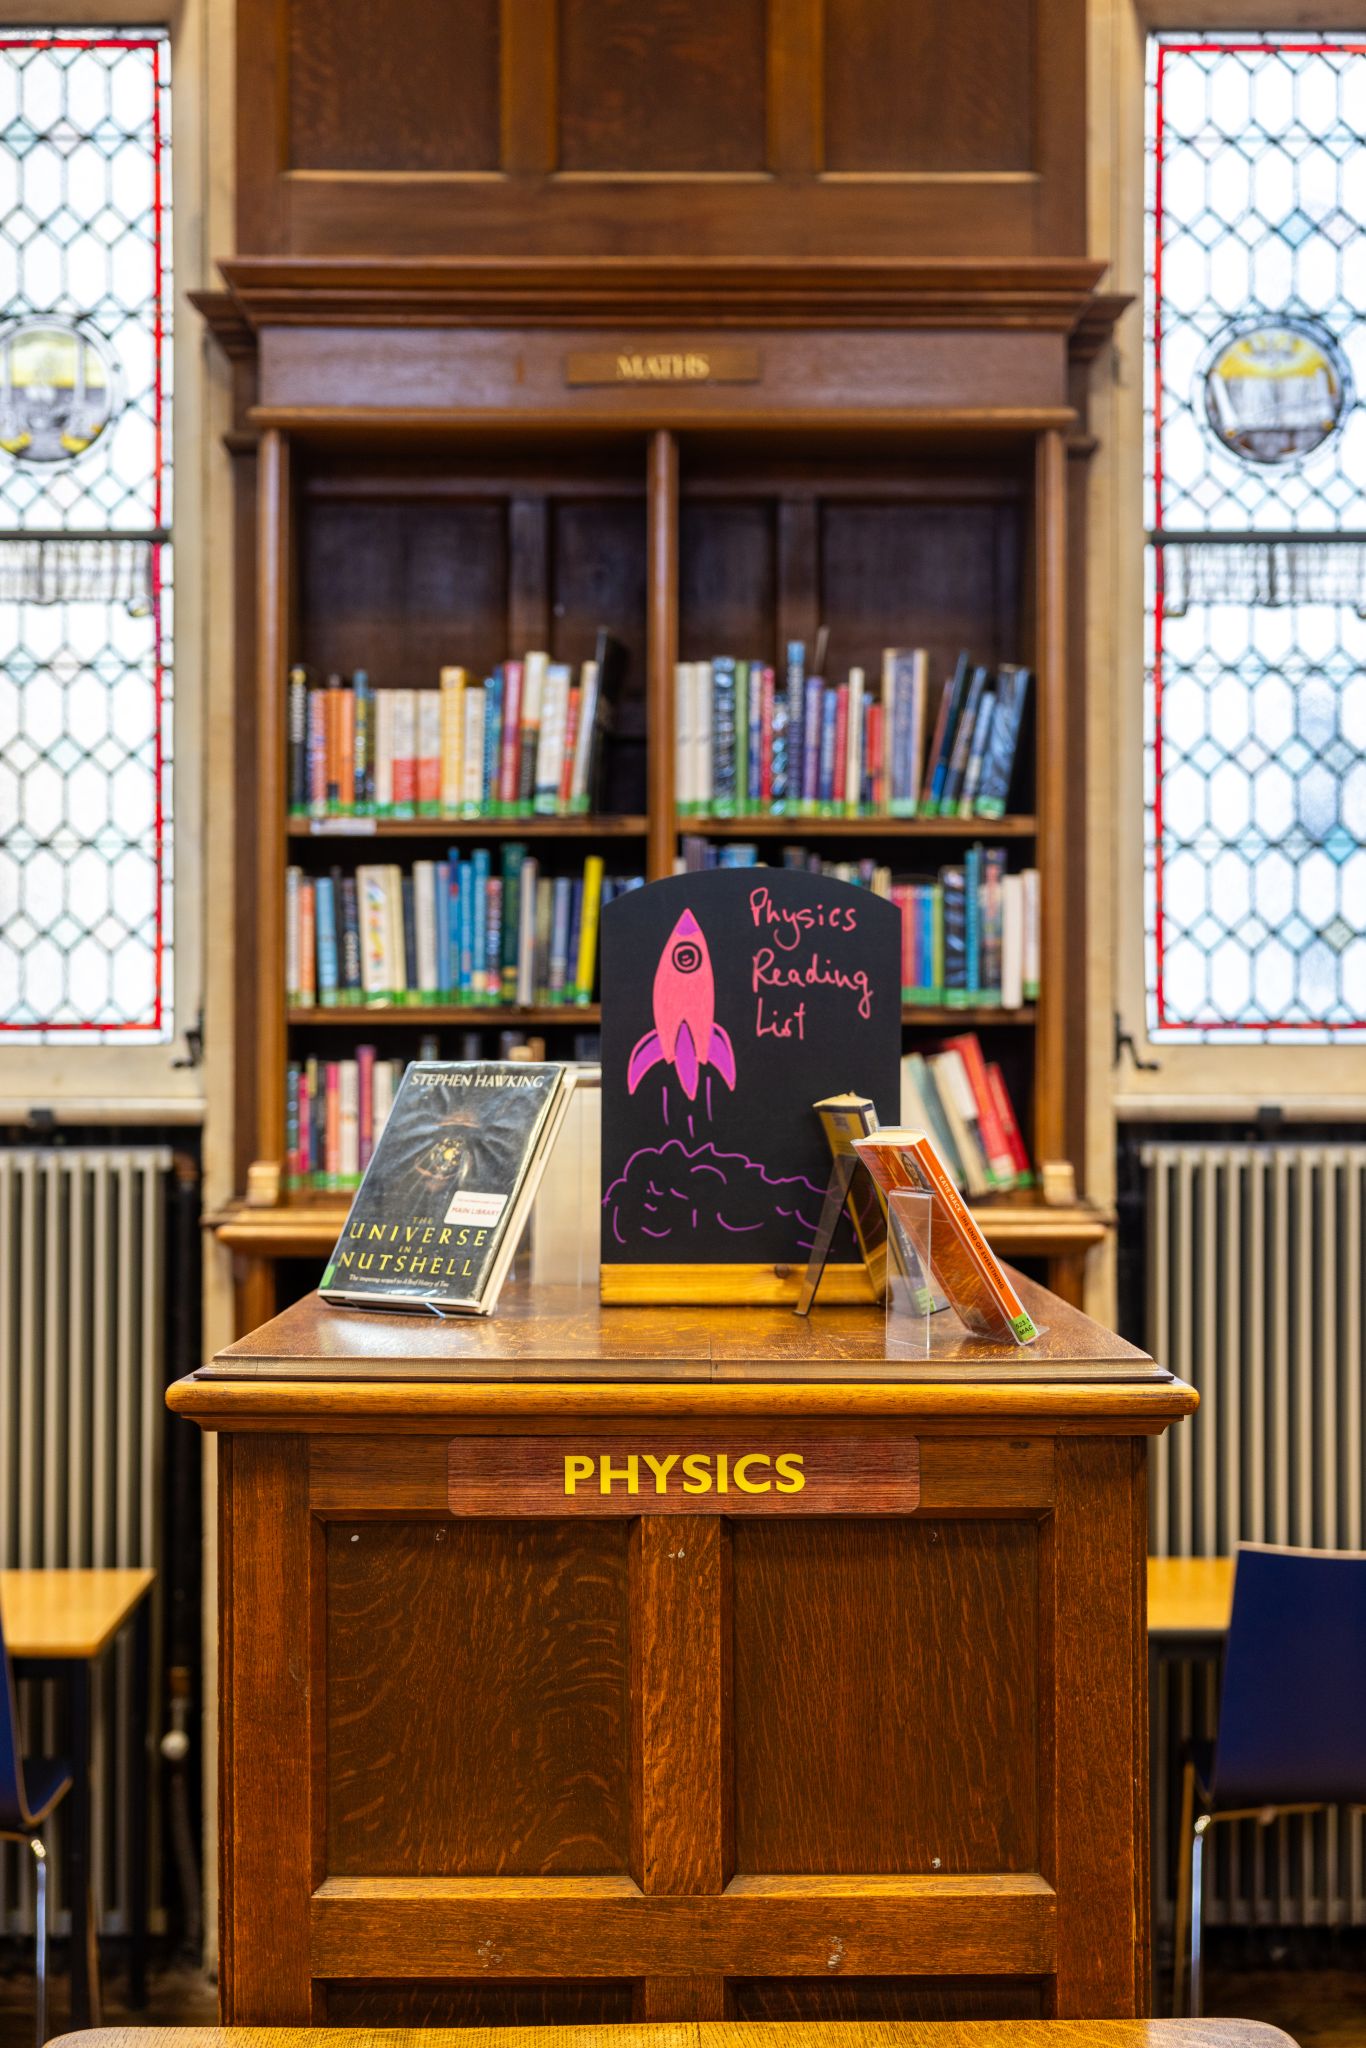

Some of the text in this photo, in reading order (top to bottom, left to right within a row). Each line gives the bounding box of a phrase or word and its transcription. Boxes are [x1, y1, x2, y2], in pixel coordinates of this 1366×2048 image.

[616, 353, 710, 380] MATHS
[750, 887, 857, 951] Physics
[752, 947, 874, 1019] Reading
[756, 997, 806, 1040] List
[410, 1073, 545, 1089] STEPHEN HAWKING
[412, 1216, 433, 1225] THE
[938, 1175, 951, 1195] KATIE
[949, 1192, 962, 1214] MACK
[960, 1215, 969, 1228] THE
[967, 1227, 977, 1242] END
[980, 1250, 1005, 1291] EVERYTHING
[350, 1222, 488, 1247] UNIVERSE
[399, 1245, 423, 1255] IN A
[337, 1251, 473, 1277] NUTSHELL
[1019, 1324, 1034, 1336] MAC
[563, 1453, 806, 1495] PHYSICS
